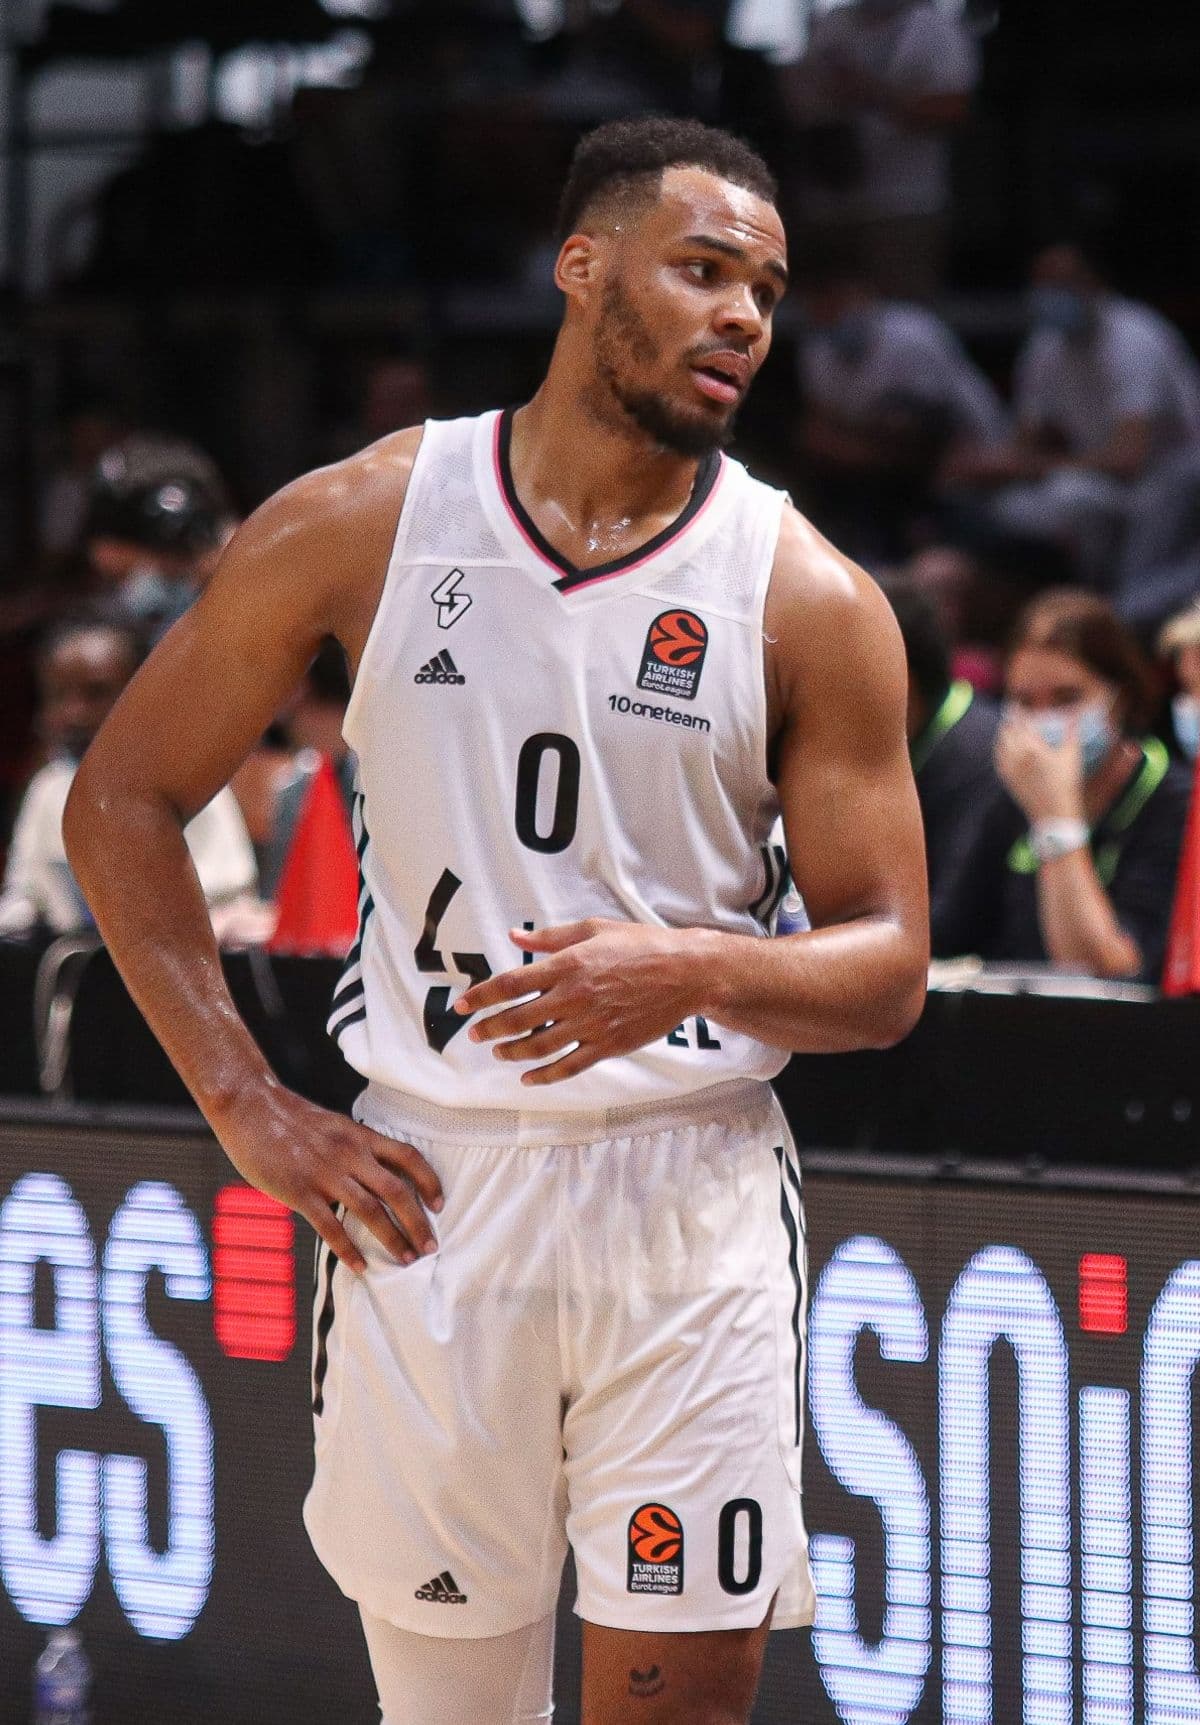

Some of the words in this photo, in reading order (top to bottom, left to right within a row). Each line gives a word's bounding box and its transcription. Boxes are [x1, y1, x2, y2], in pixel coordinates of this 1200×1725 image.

[414, 668, 466, 685] adidas
[646, 661, 697, 680] TURKISH
[643, 671, 694, 689] AIRLINES
[514, 732, 581, 855] 0
[718, 1497, 763, 1596] 0
[632, 1563, 679, 1575] TURKISH
[631, 1573, 679, 1585] AIRLINES
[414, 1589, 468, 1605] adidas
